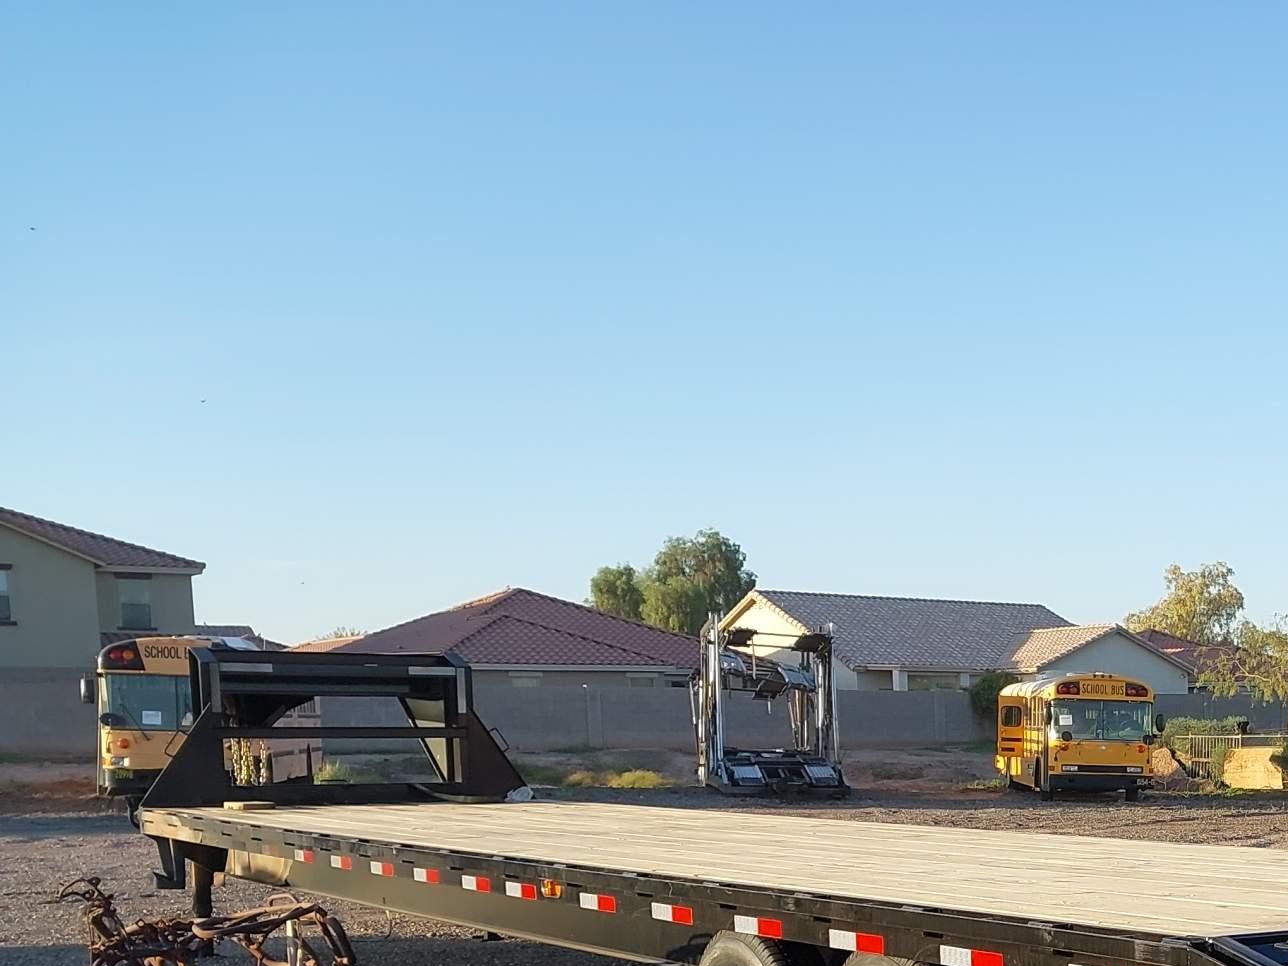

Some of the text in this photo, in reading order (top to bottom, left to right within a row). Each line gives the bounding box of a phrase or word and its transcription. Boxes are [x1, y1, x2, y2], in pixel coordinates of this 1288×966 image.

[144, 646, 182, 659] SCHOOL
[1082, 683, 1124, 695] SCHOOL BUS
